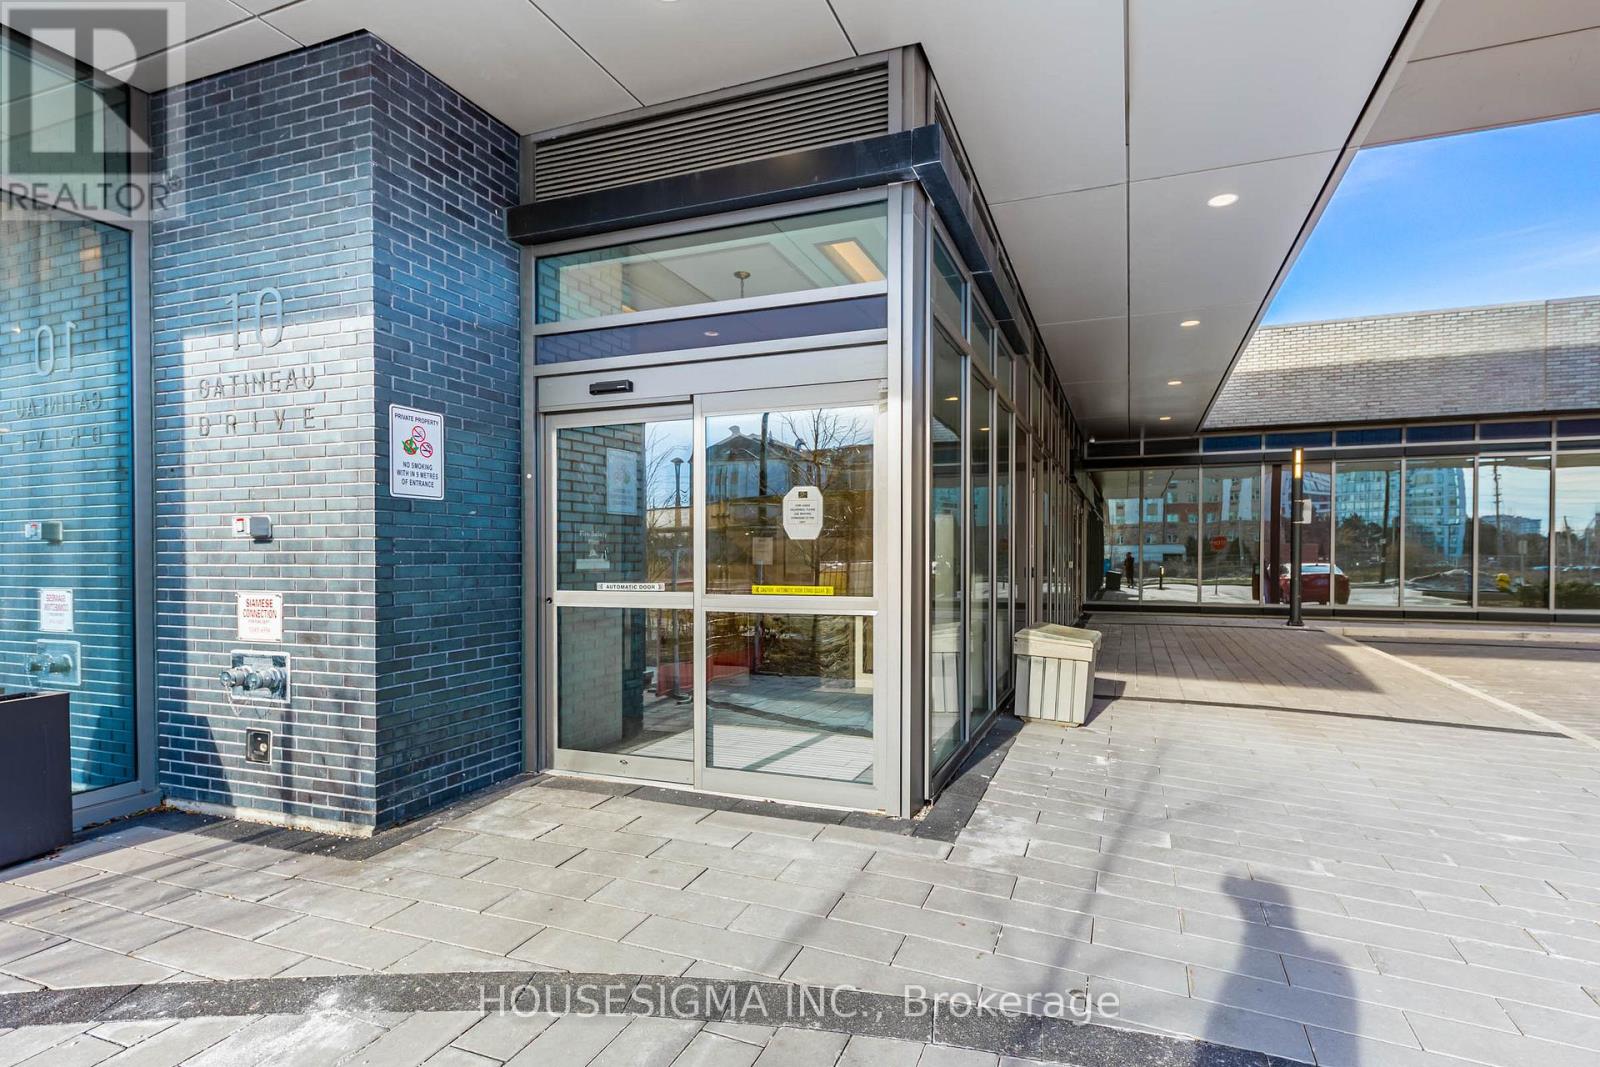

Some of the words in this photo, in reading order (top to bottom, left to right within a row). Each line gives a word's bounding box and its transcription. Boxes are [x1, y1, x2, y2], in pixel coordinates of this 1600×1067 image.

[226, 287, 284, 351] 10
[199, 366, 316, 399] GATINEAU
[394, 412, 414, 422] PRIVATE
[415, 416, 439, 426] PROPERTY
[402, 461, 411, 469] NO
[411, 462, 433, 471] SMOKING
[420, 471, 439, 480] METRES
[401, 478, 408, 486] OF
[409, 479, 435, 488] ENTRANCE
[245, 598, 273, 608] SIAMESE
[242, 608, 278, 619] CONNECTION
